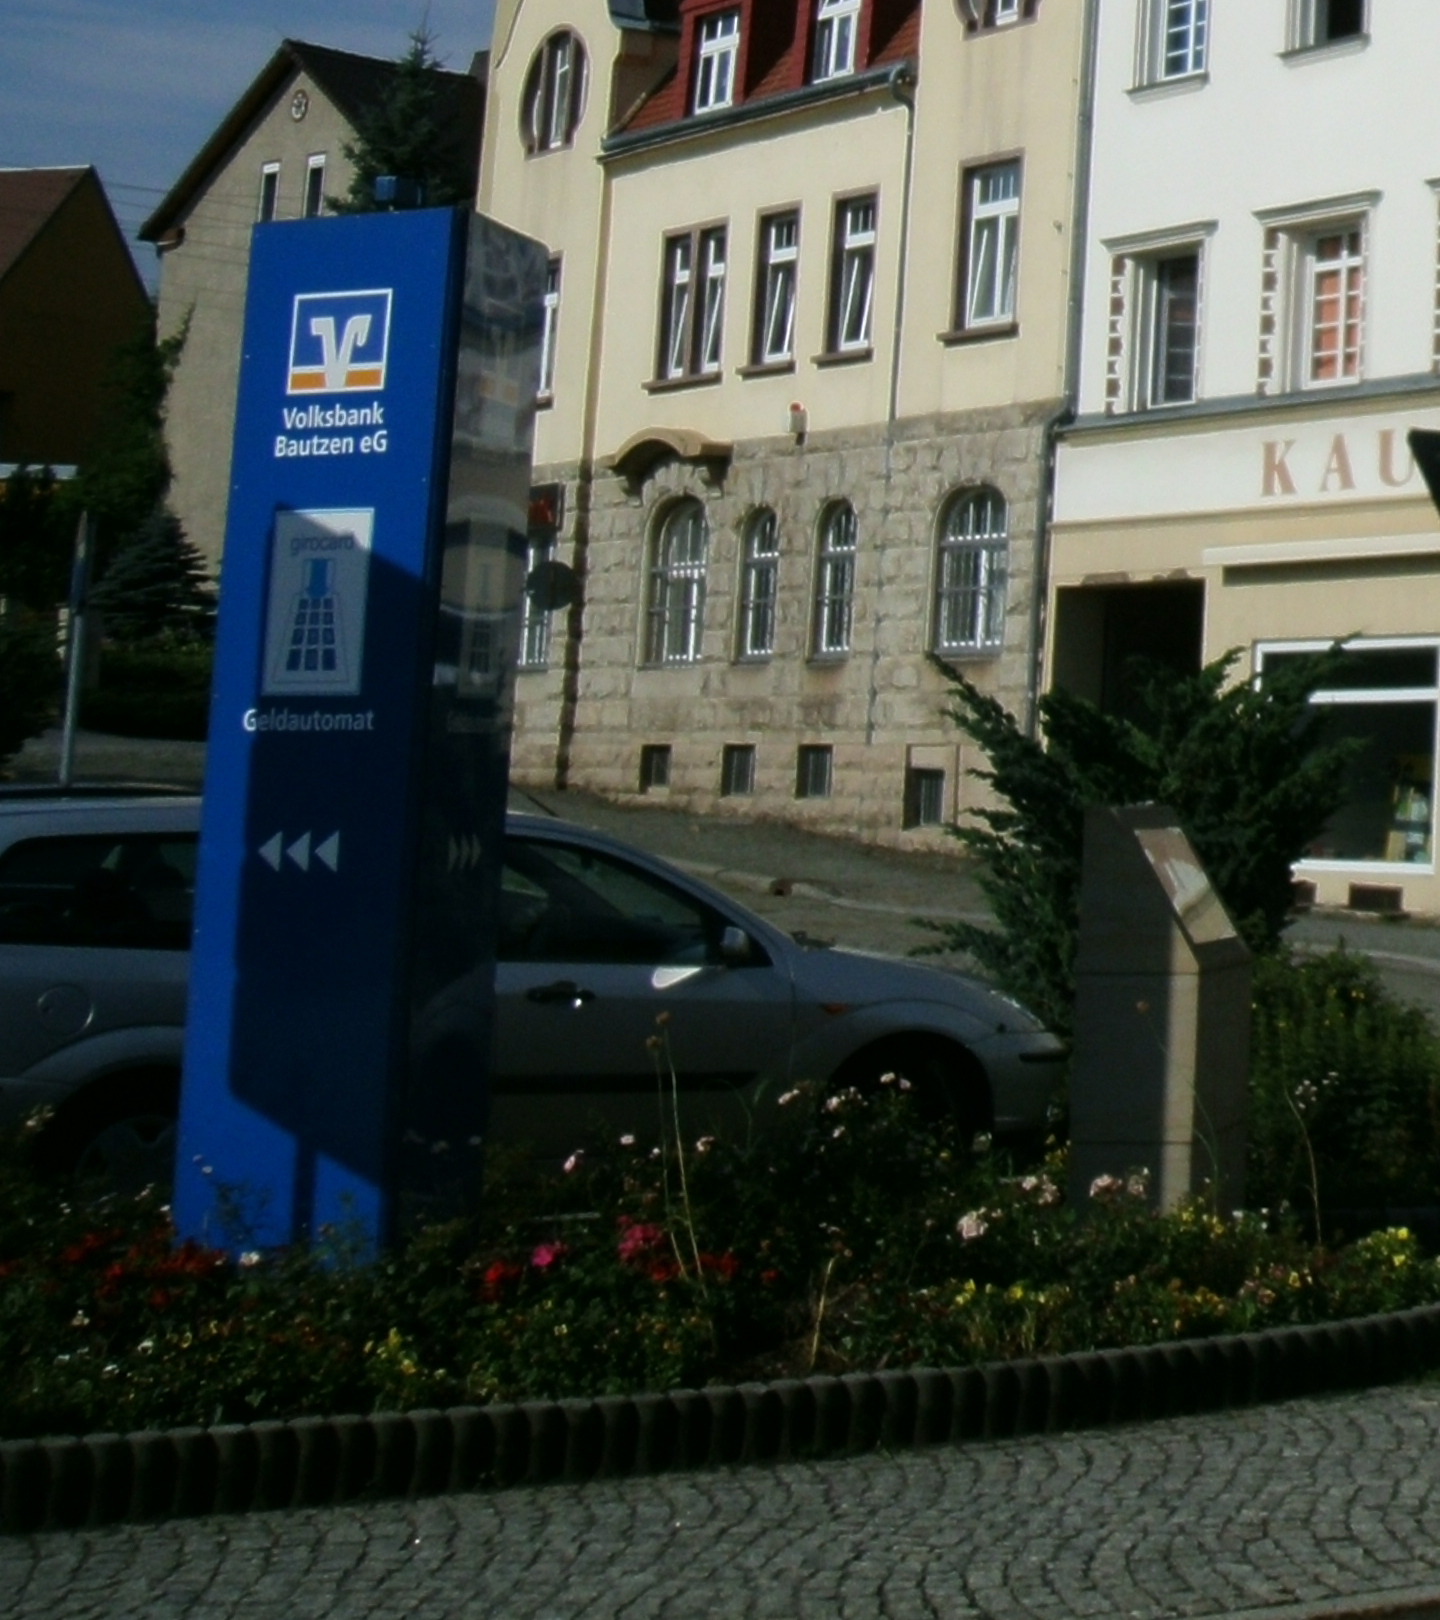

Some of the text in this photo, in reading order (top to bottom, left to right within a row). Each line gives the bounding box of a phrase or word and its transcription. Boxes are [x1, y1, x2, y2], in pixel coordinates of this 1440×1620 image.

[283, 400, 384, 429] Volksbank
[274, 430, 388, 457] Bautzen eG
[243, 707, 375, 732] Geldautomat
